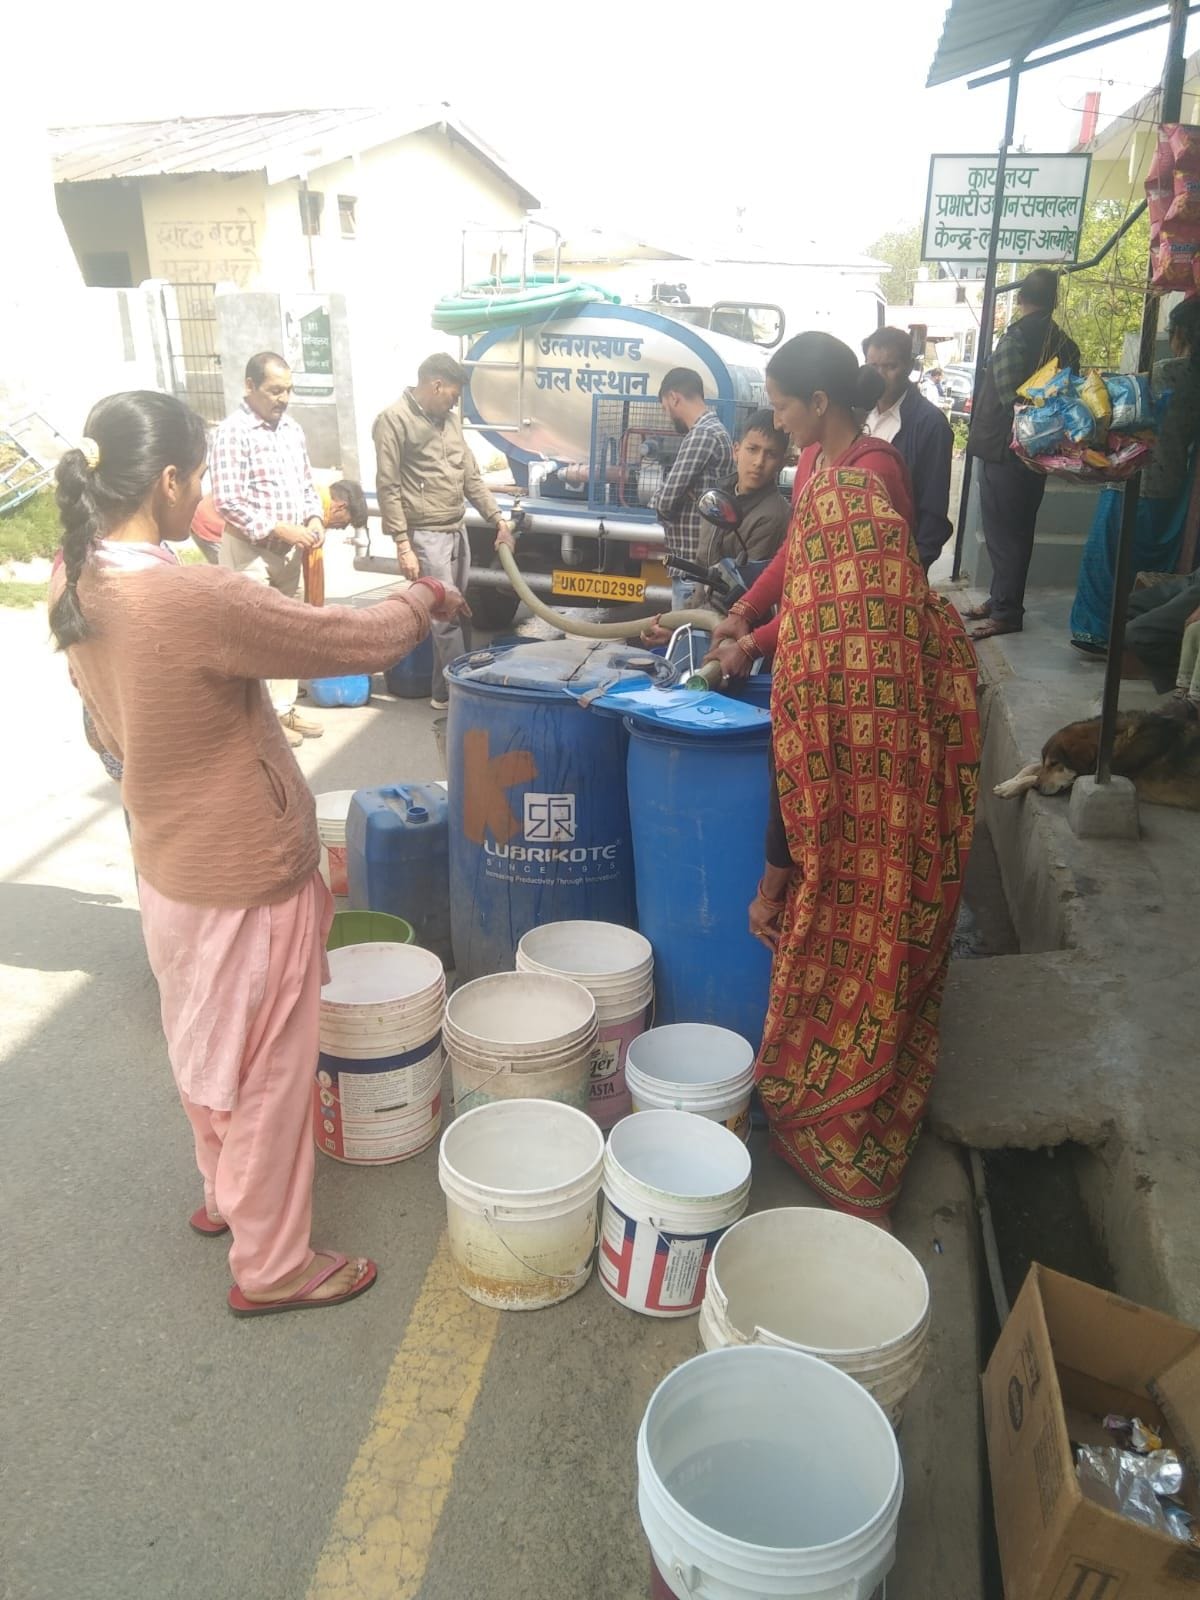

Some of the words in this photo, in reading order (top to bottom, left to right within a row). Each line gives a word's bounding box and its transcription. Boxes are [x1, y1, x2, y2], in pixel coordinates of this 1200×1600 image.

[935, 190, 980, 217] प्रभारी
[539, 332, 644, 361] उत्तराखण्ड
[535, 366, 572, 394] जल
[576, 362, 650, 395] संस्थान
[561, 576, 644, 598] UK07CD2998
[483, 839, 617, 863] LUBRIKOTE
[486, 858, 547, 874] SINCE
[590, 1058, 614, 1074] ger
[589, 1081, 614, 1097] ASTA
